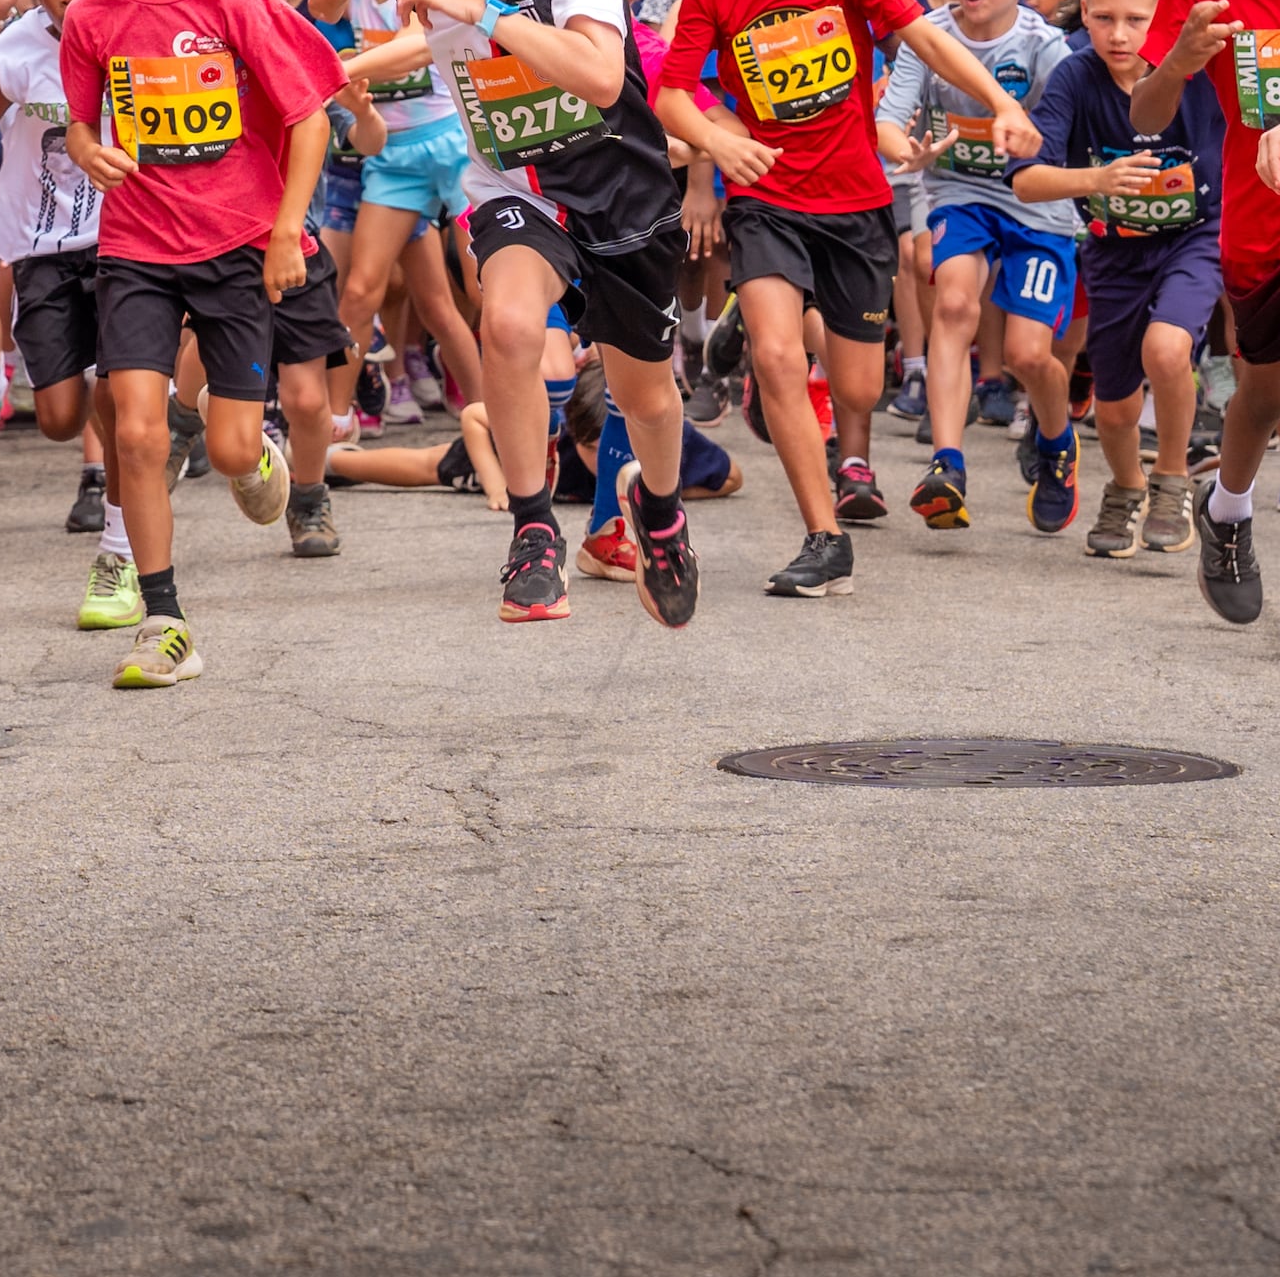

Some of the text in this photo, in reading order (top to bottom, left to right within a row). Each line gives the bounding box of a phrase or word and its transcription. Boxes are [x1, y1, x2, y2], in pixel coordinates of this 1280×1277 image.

[145, 74, 178, 85] Microsoft
[485, 75, 517, 87] Microsoft
[735, 35, 764, 84] MILE
[768, 47, 851, 95] 9270
[1236, 33, 1259, 89] MILE
[112, 60, 136, 117] MILE
[453, 64, 487, 125] MILE
[140, 101, 233, 136] 9109
[490, 91, 588, 143] 8279
[1109, 195, 1192, 221] 8202
[1020, 256, 1058, 304] 10
